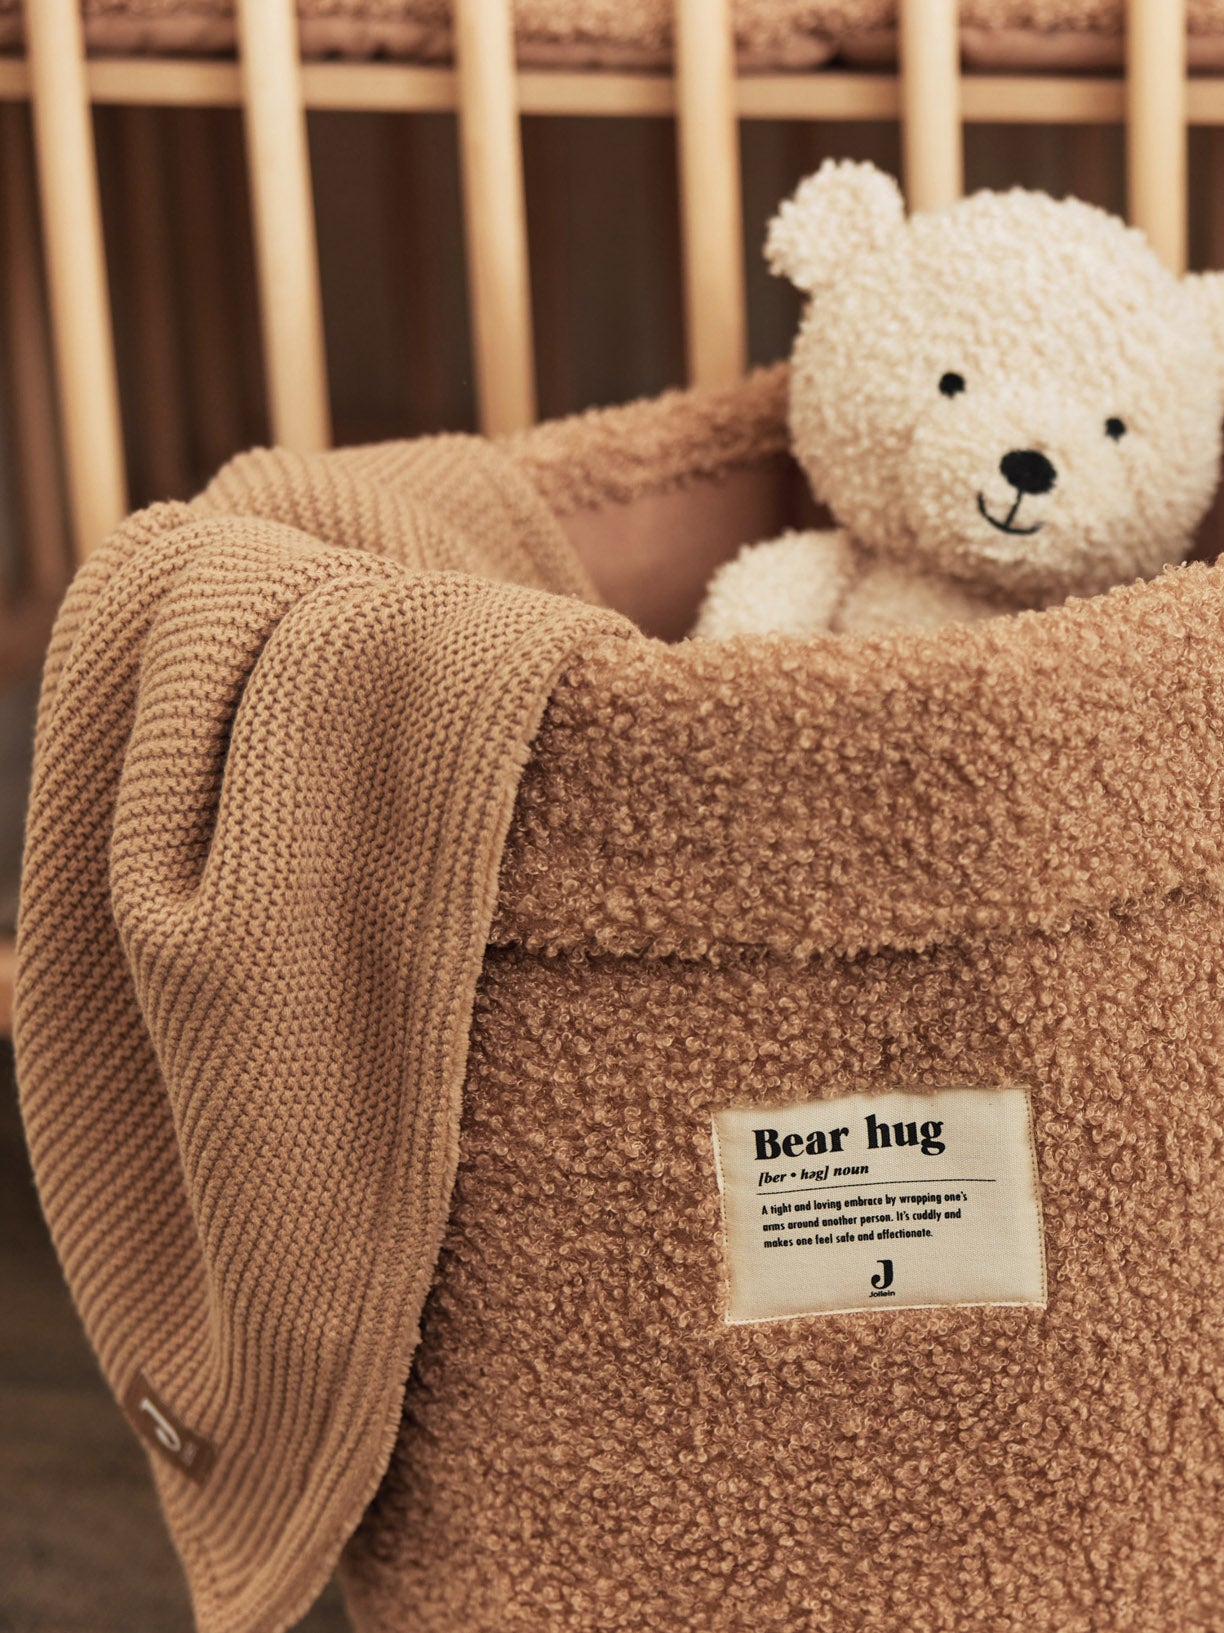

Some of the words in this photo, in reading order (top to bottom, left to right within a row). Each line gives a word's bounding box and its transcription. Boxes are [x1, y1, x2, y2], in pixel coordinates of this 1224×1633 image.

[752, 1127, 849, 1160] Bear
[864, 1113, 946, 1156] hug
[758, 1172, 787, 1187] [ber
[833, 1165, 870, 1177] noun
[761, 1205, 768, 1215] A
[770, 1203, 791, 1216] tight
[794, 1200, 811, 1212] and
[814, 1199, 842, 1211] loving
[844, 1196, 883, 1208] embrace
[885, 1194, 896, 1206] by
[899, 1192, 942, 1205] wrapping
[762, 1223, 785, 1231] arms
[788, 1217, 820, 1229] around
[822, 1215, 857, 1227] another
[860, 1214, 894, 1226] person.
[912, 1209, 941, 1222] cuddly
[944, 1208, 961, 1219] and
[764, 1237, 793, 1248] makes
[796, 1238, 813, 1246] one
[815, 1234, 833, 1245] feel
[836, 1232, 855, 1244] safe
[857, 1230, 874, 1241] and
[877, 1229, 933, 1241] affectionate.
[871, 1259, 893, 1290] J
